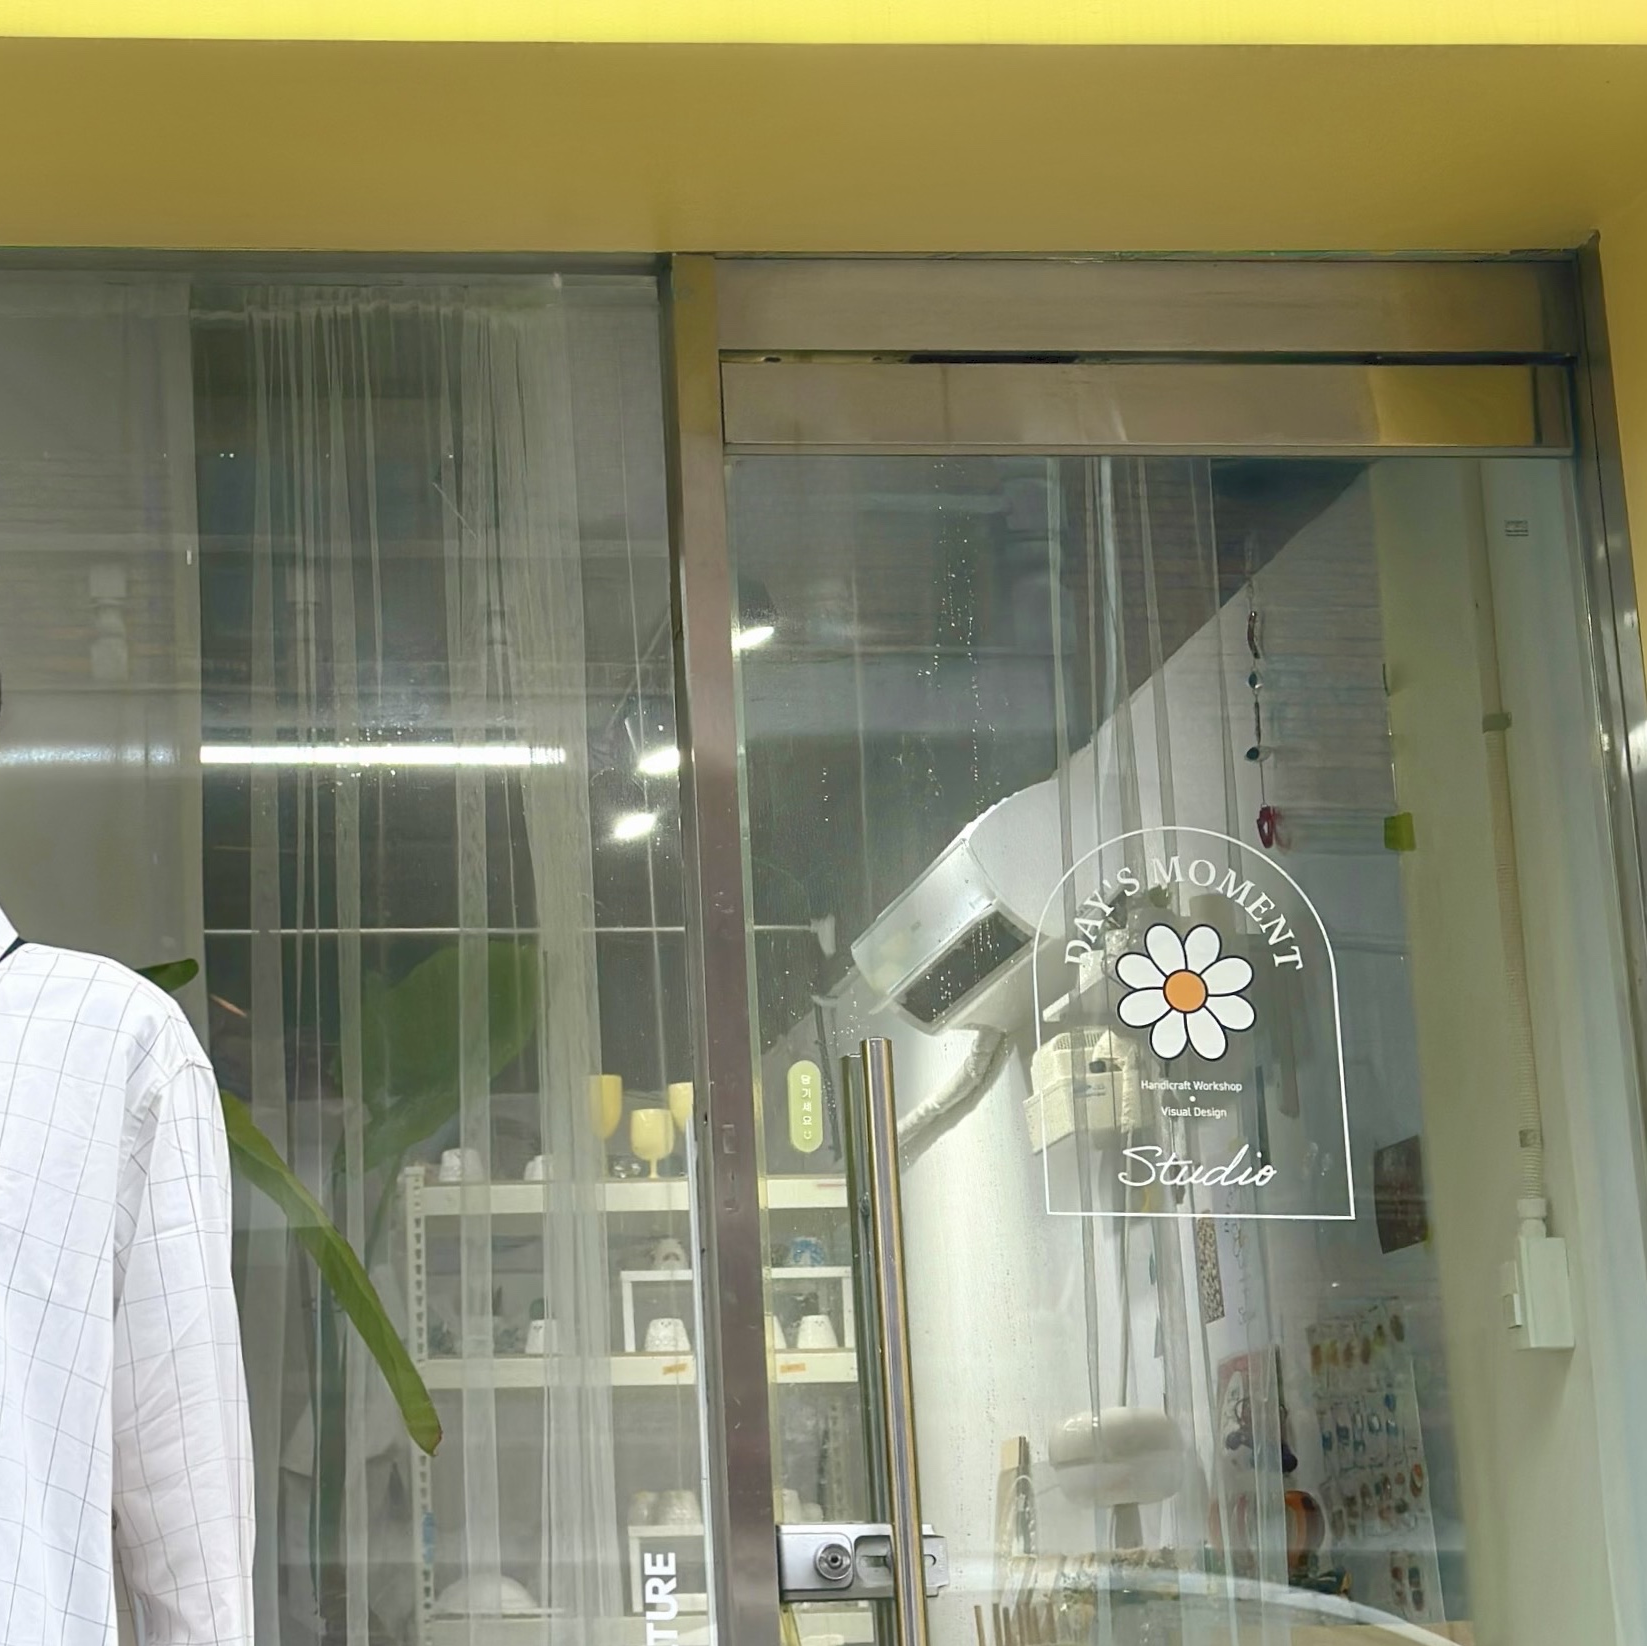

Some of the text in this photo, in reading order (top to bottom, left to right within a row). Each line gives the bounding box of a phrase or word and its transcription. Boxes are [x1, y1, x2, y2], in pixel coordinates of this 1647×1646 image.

[1064, 856, 1303, 970] DAY'S MOMENT
[1140, 1080, 1243, 1093] Handicraft Workshop
[1161, 1106, 1227, 1119] Visual Design
[1118, 1144, 1277, 1187] Studio
